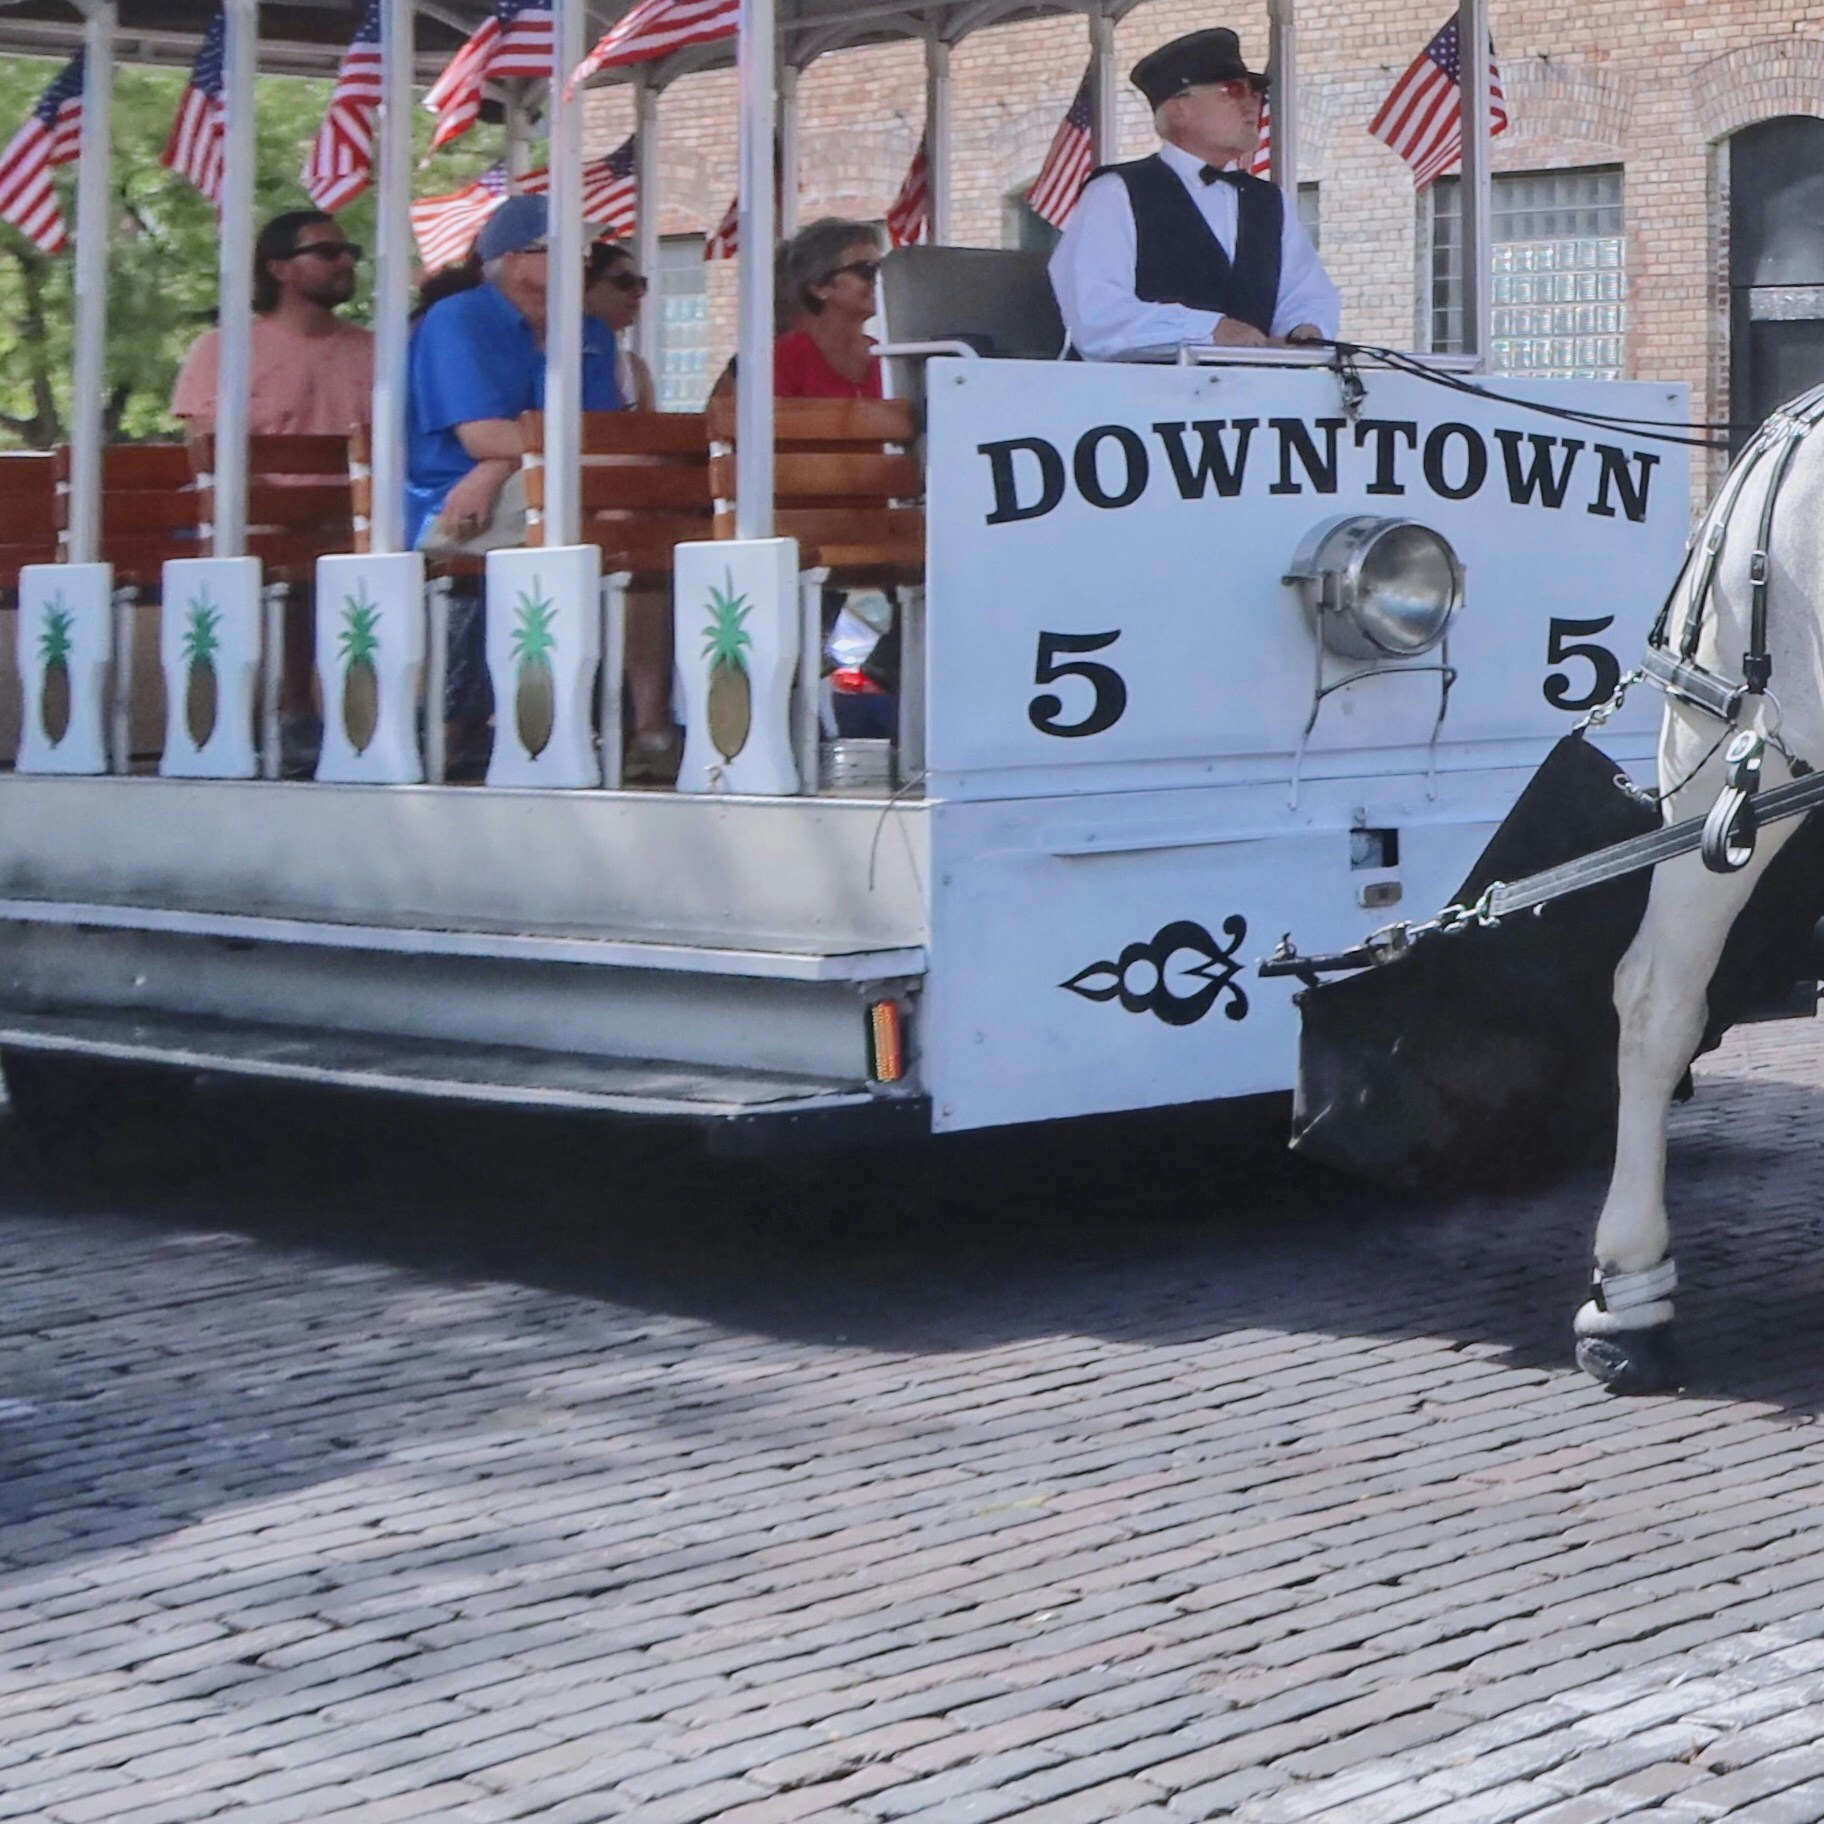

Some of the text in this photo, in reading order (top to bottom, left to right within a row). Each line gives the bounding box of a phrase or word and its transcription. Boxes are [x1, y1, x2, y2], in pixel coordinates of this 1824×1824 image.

[977, 416, 1660, 524] DOWNTOWN
[1028, 628, 1128, 738] 5
[1542, 614, 1621, 712] 5
